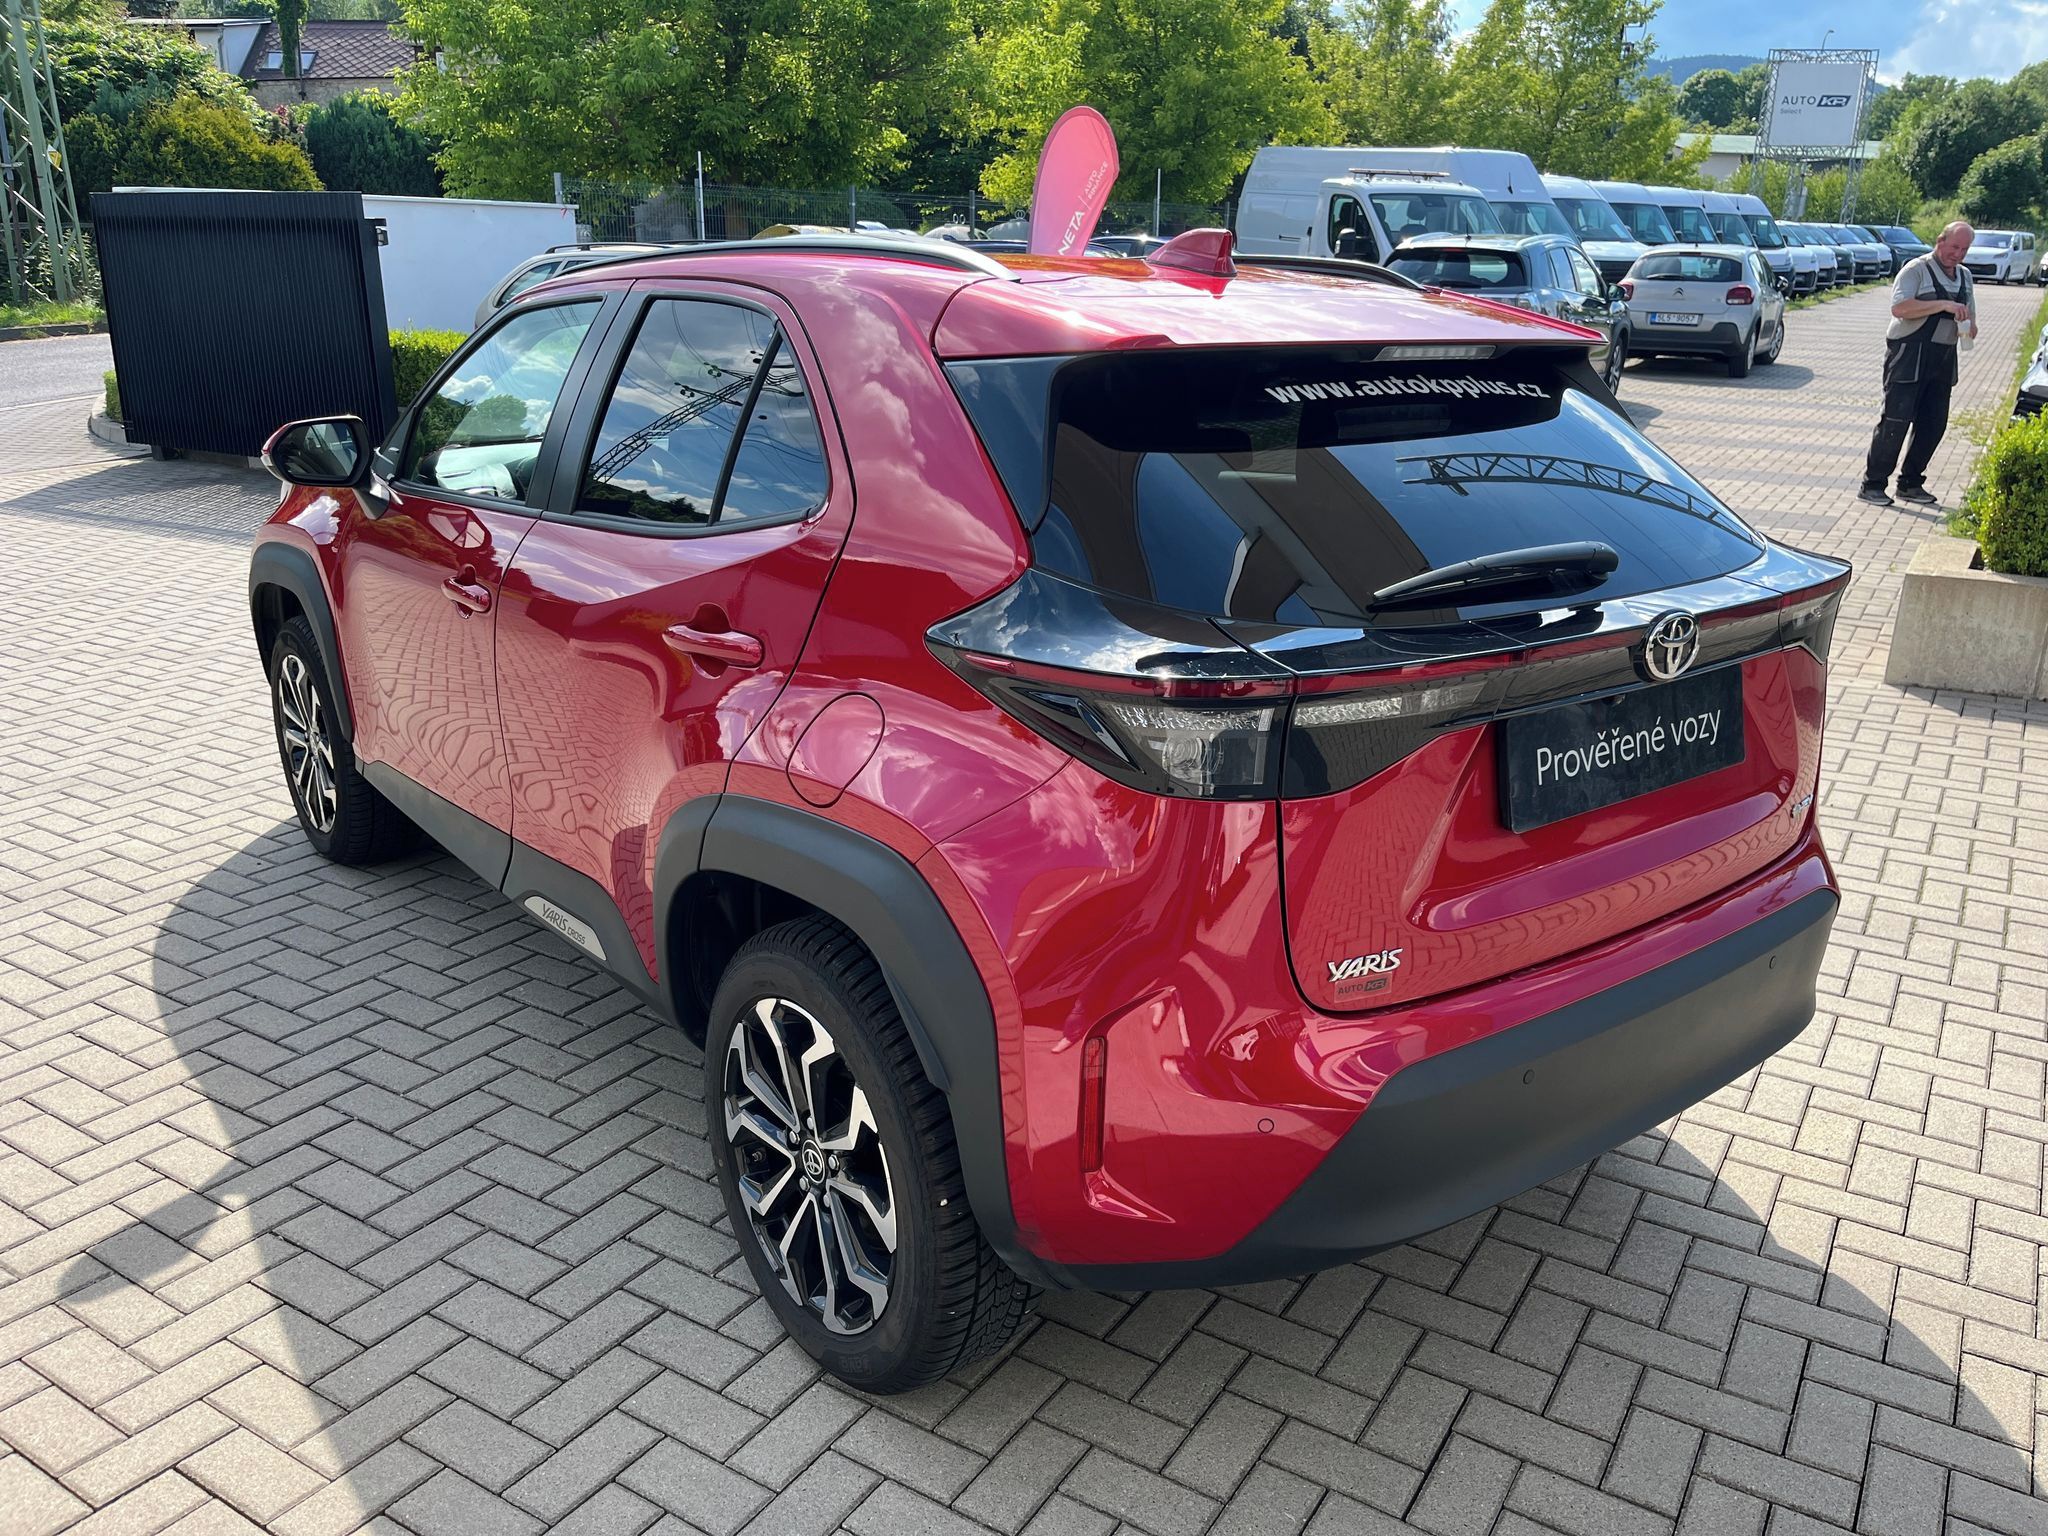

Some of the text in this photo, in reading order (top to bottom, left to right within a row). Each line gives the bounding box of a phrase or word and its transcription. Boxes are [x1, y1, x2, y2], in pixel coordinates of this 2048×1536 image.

[1782, 96, 1816, 105] AUTO
[1084, 170, 1098, 194] AUTO
[1088, 160, 1109, 199] FINANCE
[1264, 374, 1551, 403] www.autokpplus.cz
[1536, 709, 1721, 785] Prověřené vozy
[542, 904, 586, 945] YARIS CROSS
[1328, 948, 1403, 982] YARIS
[1338, 984, 1363, 994] AUTO
